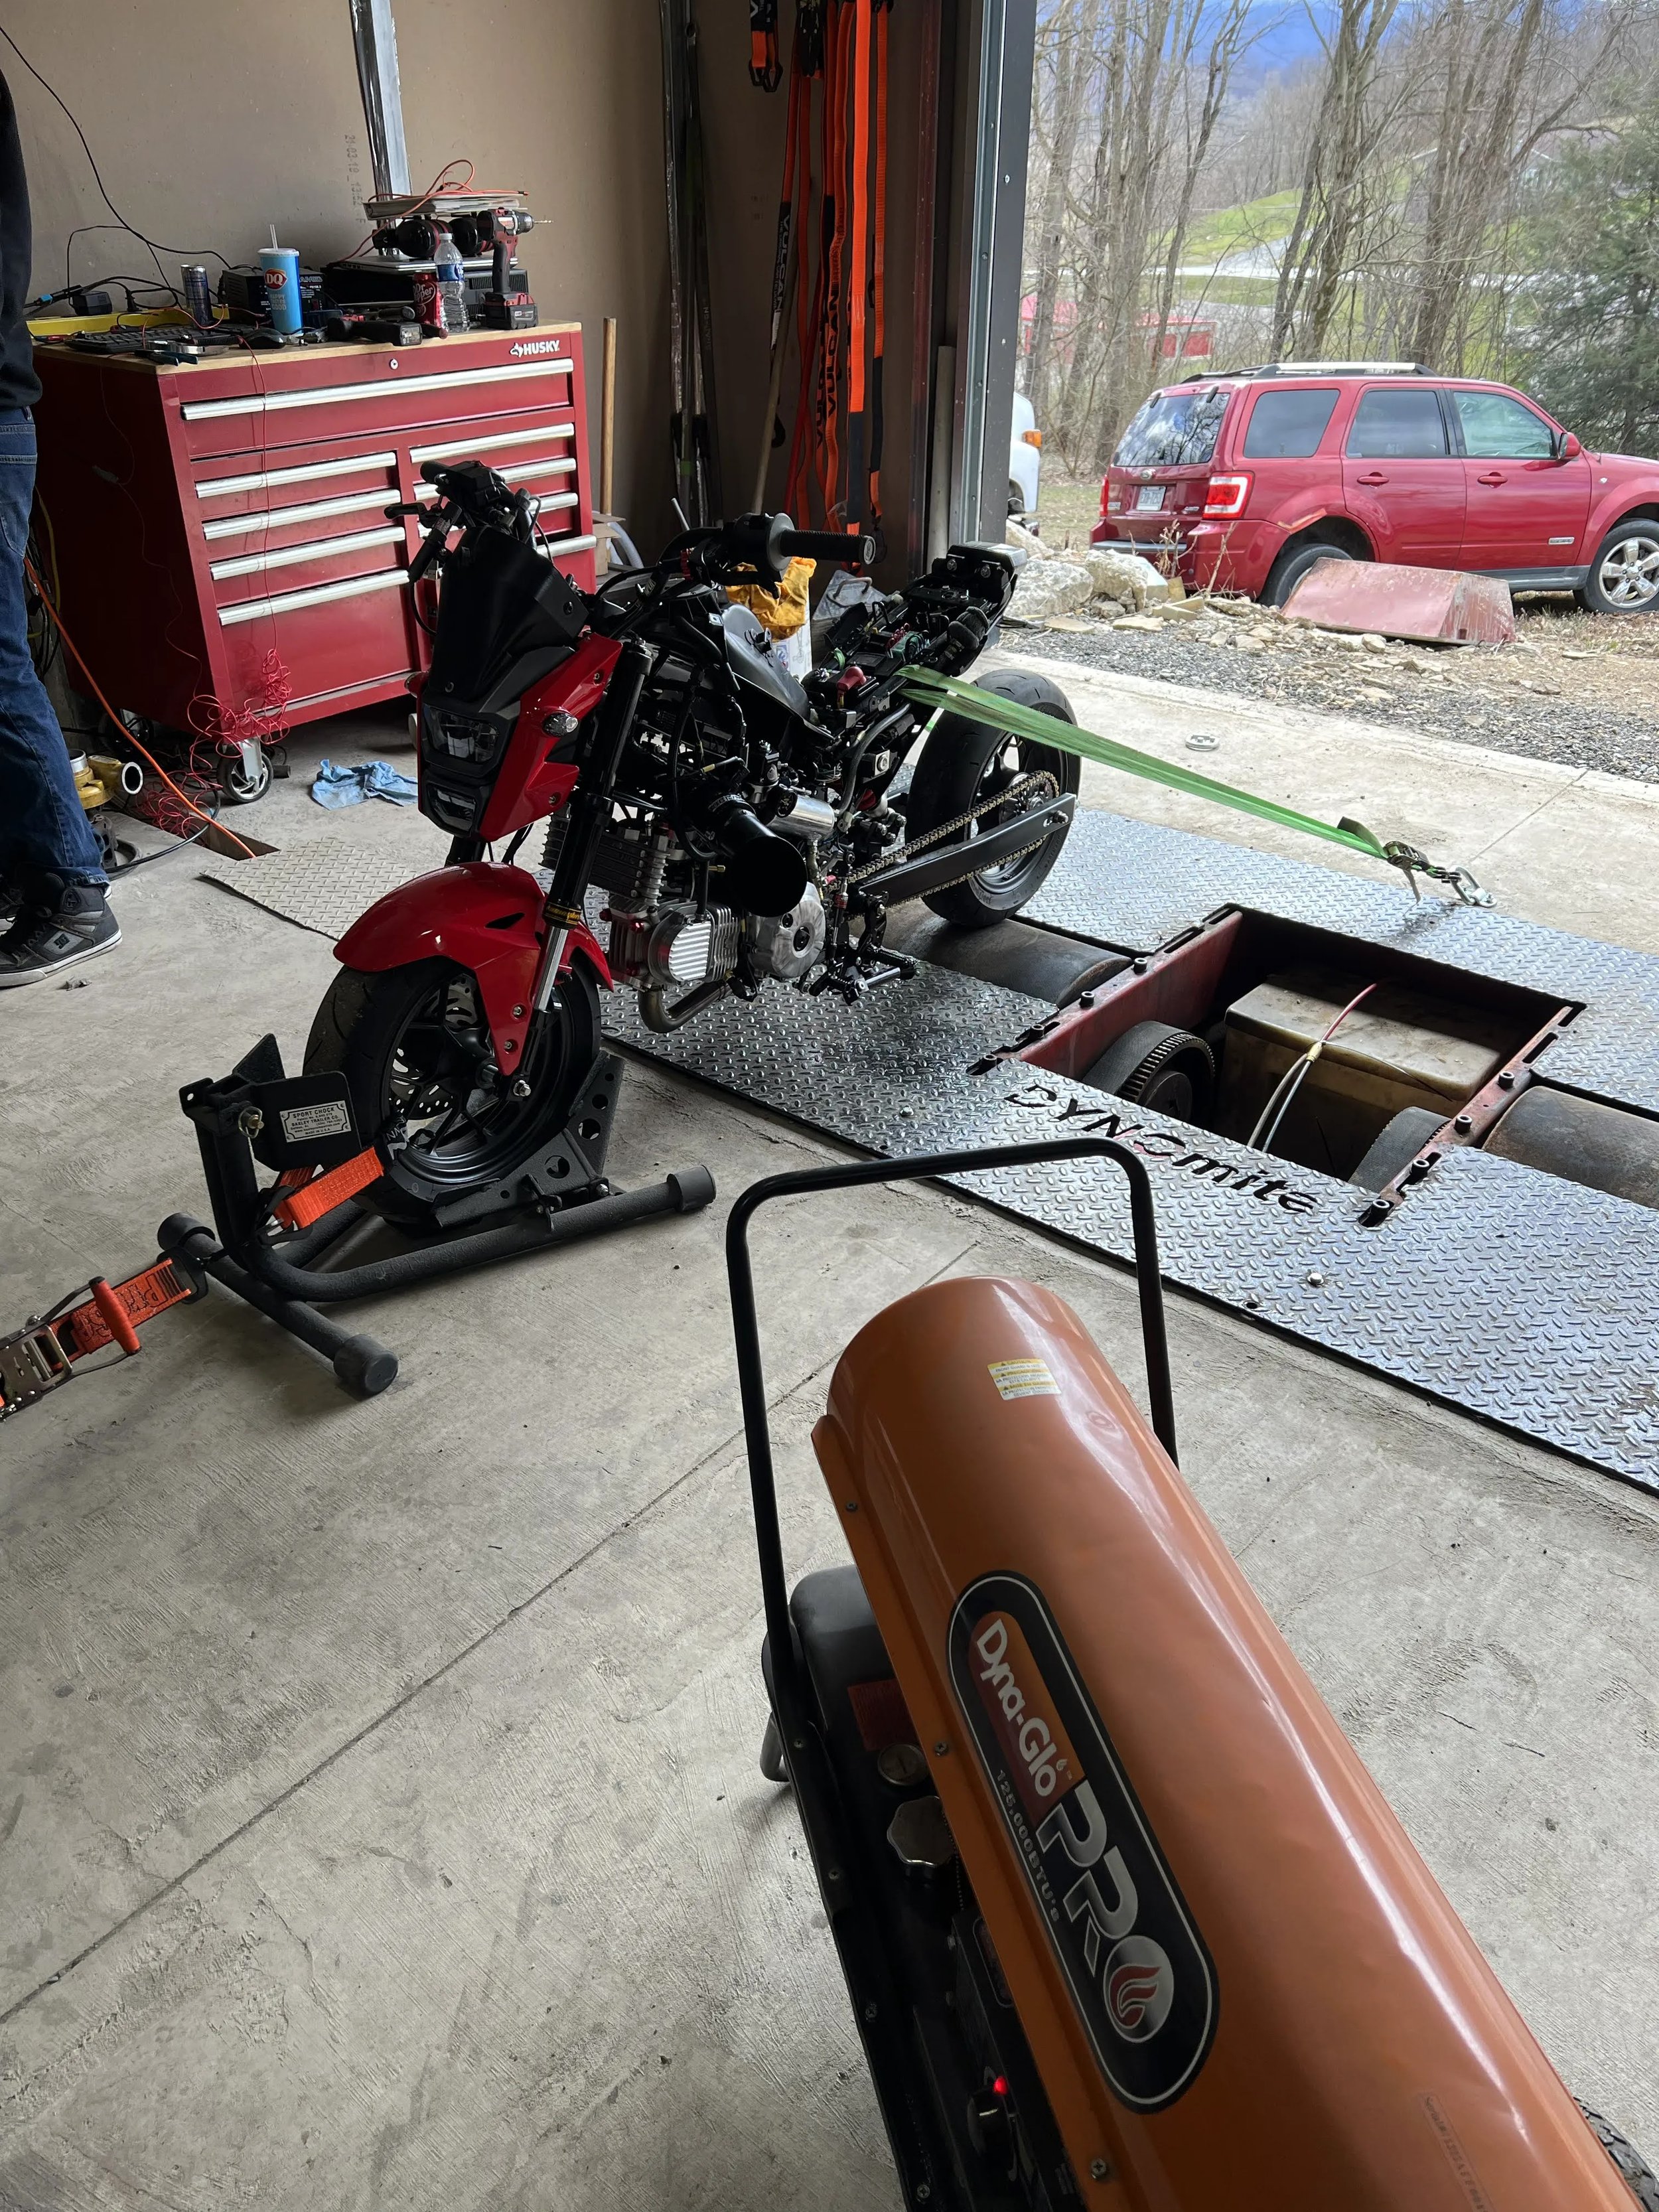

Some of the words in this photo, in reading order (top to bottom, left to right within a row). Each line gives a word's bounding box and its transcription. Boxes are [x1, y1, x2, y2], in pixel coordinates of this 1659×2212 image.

[266, 273, 283, 286] DQ
[774, 214, 790, 313] VULCAN
[523, 340, 560, 356] HUSKY
[826, 295, 839, 417] VULCAN
[975, 1619, 1057, 1799] Dyna-Glo
[1036, 1781, 1175, 2043] PRO
